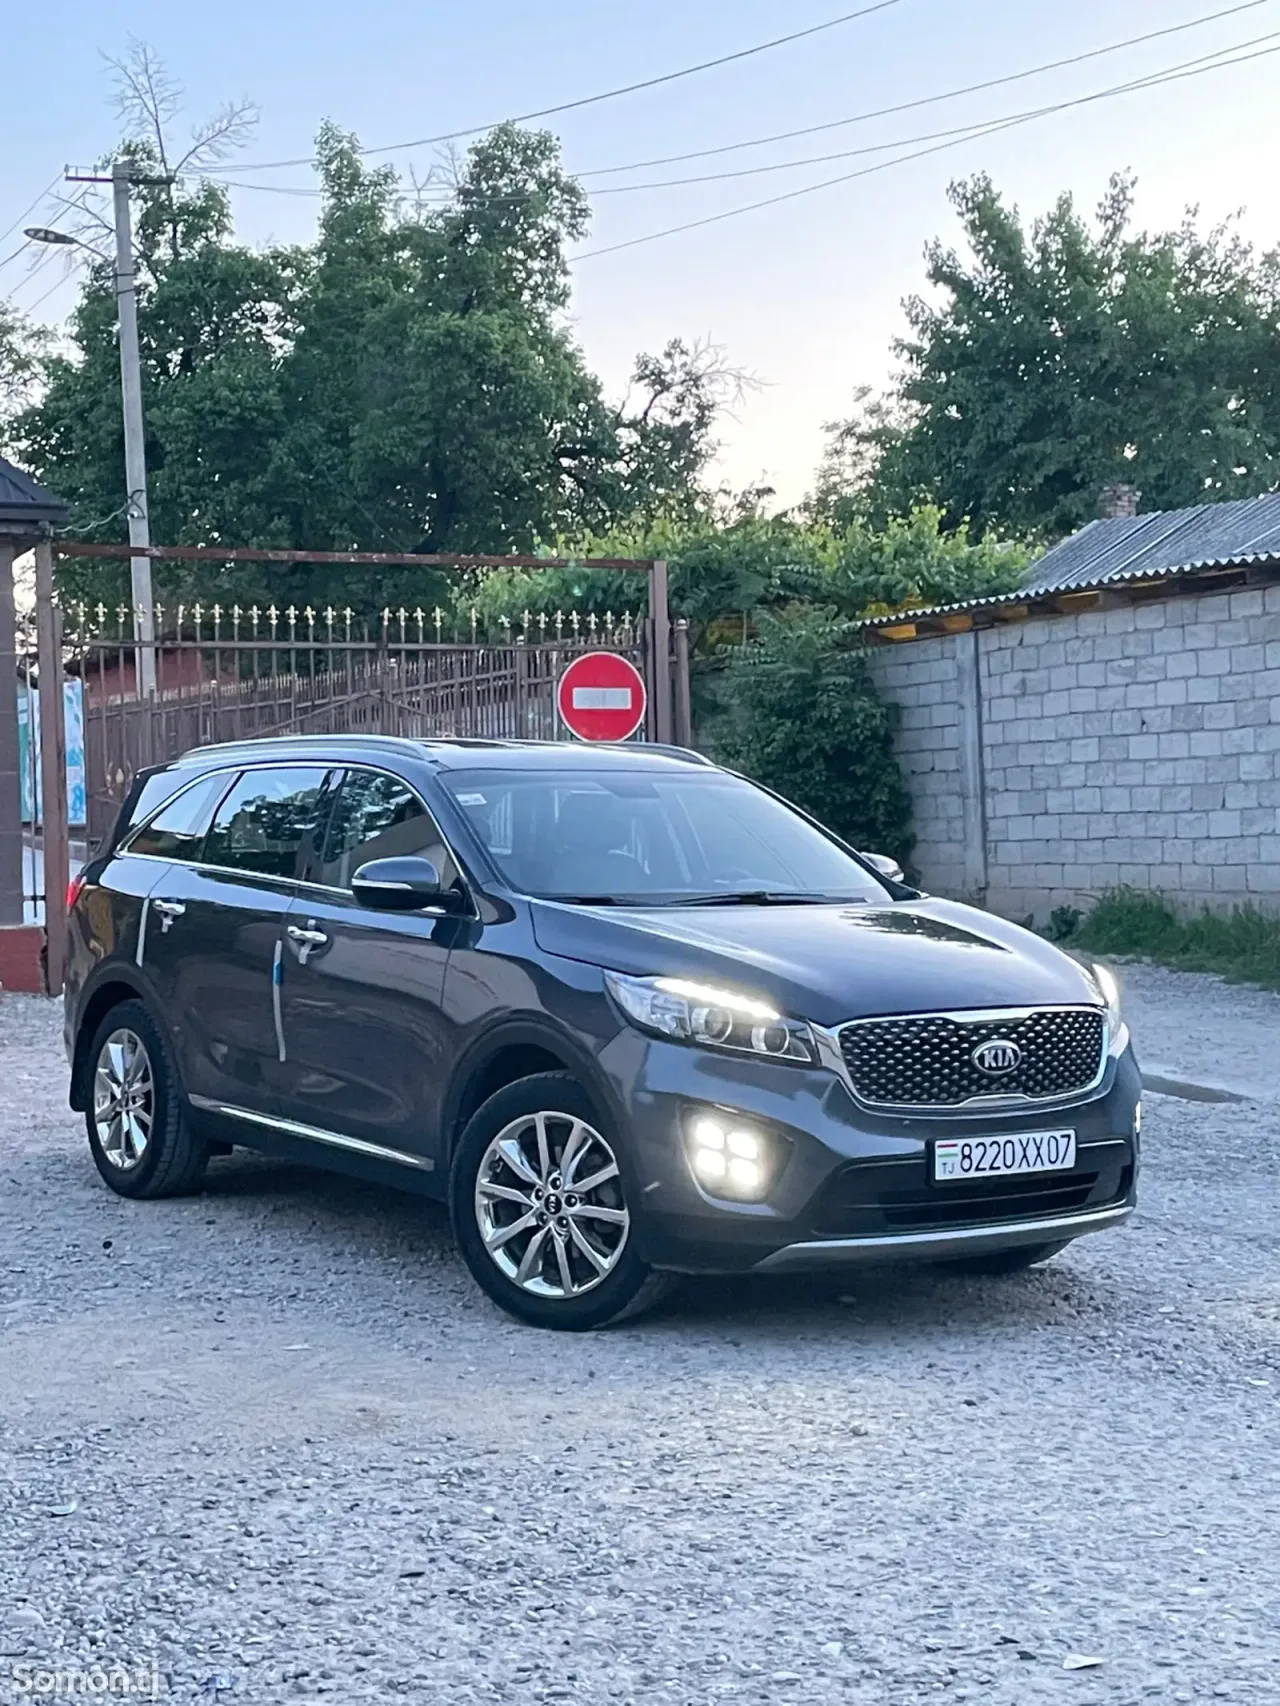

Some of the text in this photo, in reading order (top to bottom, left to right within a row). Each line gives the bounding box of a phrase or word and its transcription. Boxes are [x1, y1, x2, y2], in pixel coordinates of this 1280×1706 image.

[983, 1048, 1015, 1068] KIA
[960, 1134, 1071, 1173] 8220XX07
[941, 1162, 955, 1175] TJ
